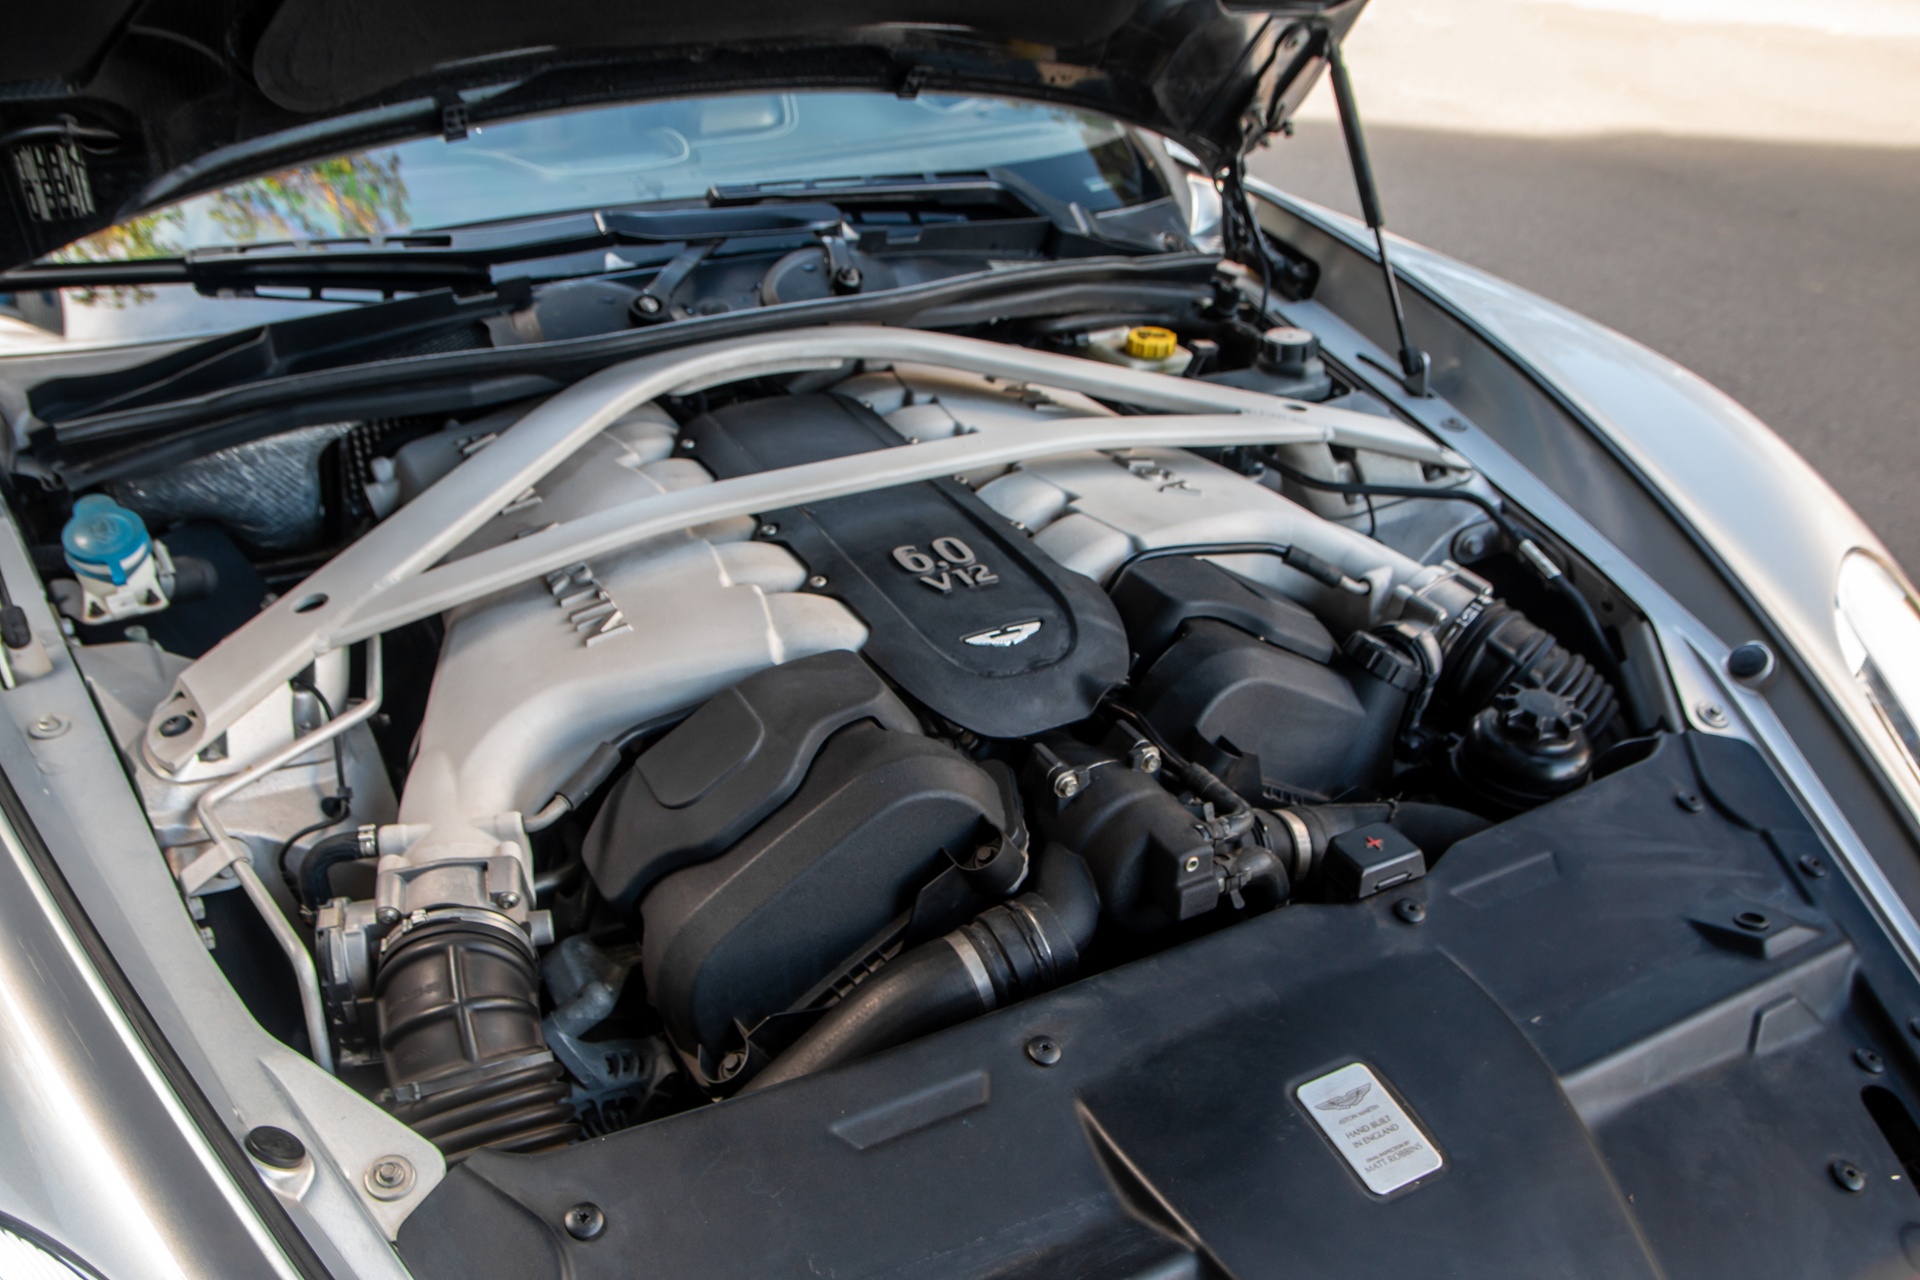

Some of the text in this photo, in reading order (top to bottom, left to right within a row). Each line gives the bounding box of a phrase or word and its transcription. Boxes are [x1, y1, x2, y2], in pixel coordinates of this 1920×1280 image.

[892, 537, 976, 574] 6.0
[919, 564, 999, 594] V12
[1345, 1114, 1391, 1139] HAND BUILT
[1352, 1123, 1400, 1149] IN ENGLAND
[1364, 1142, 1423, 1173] MATT ROBBINS
